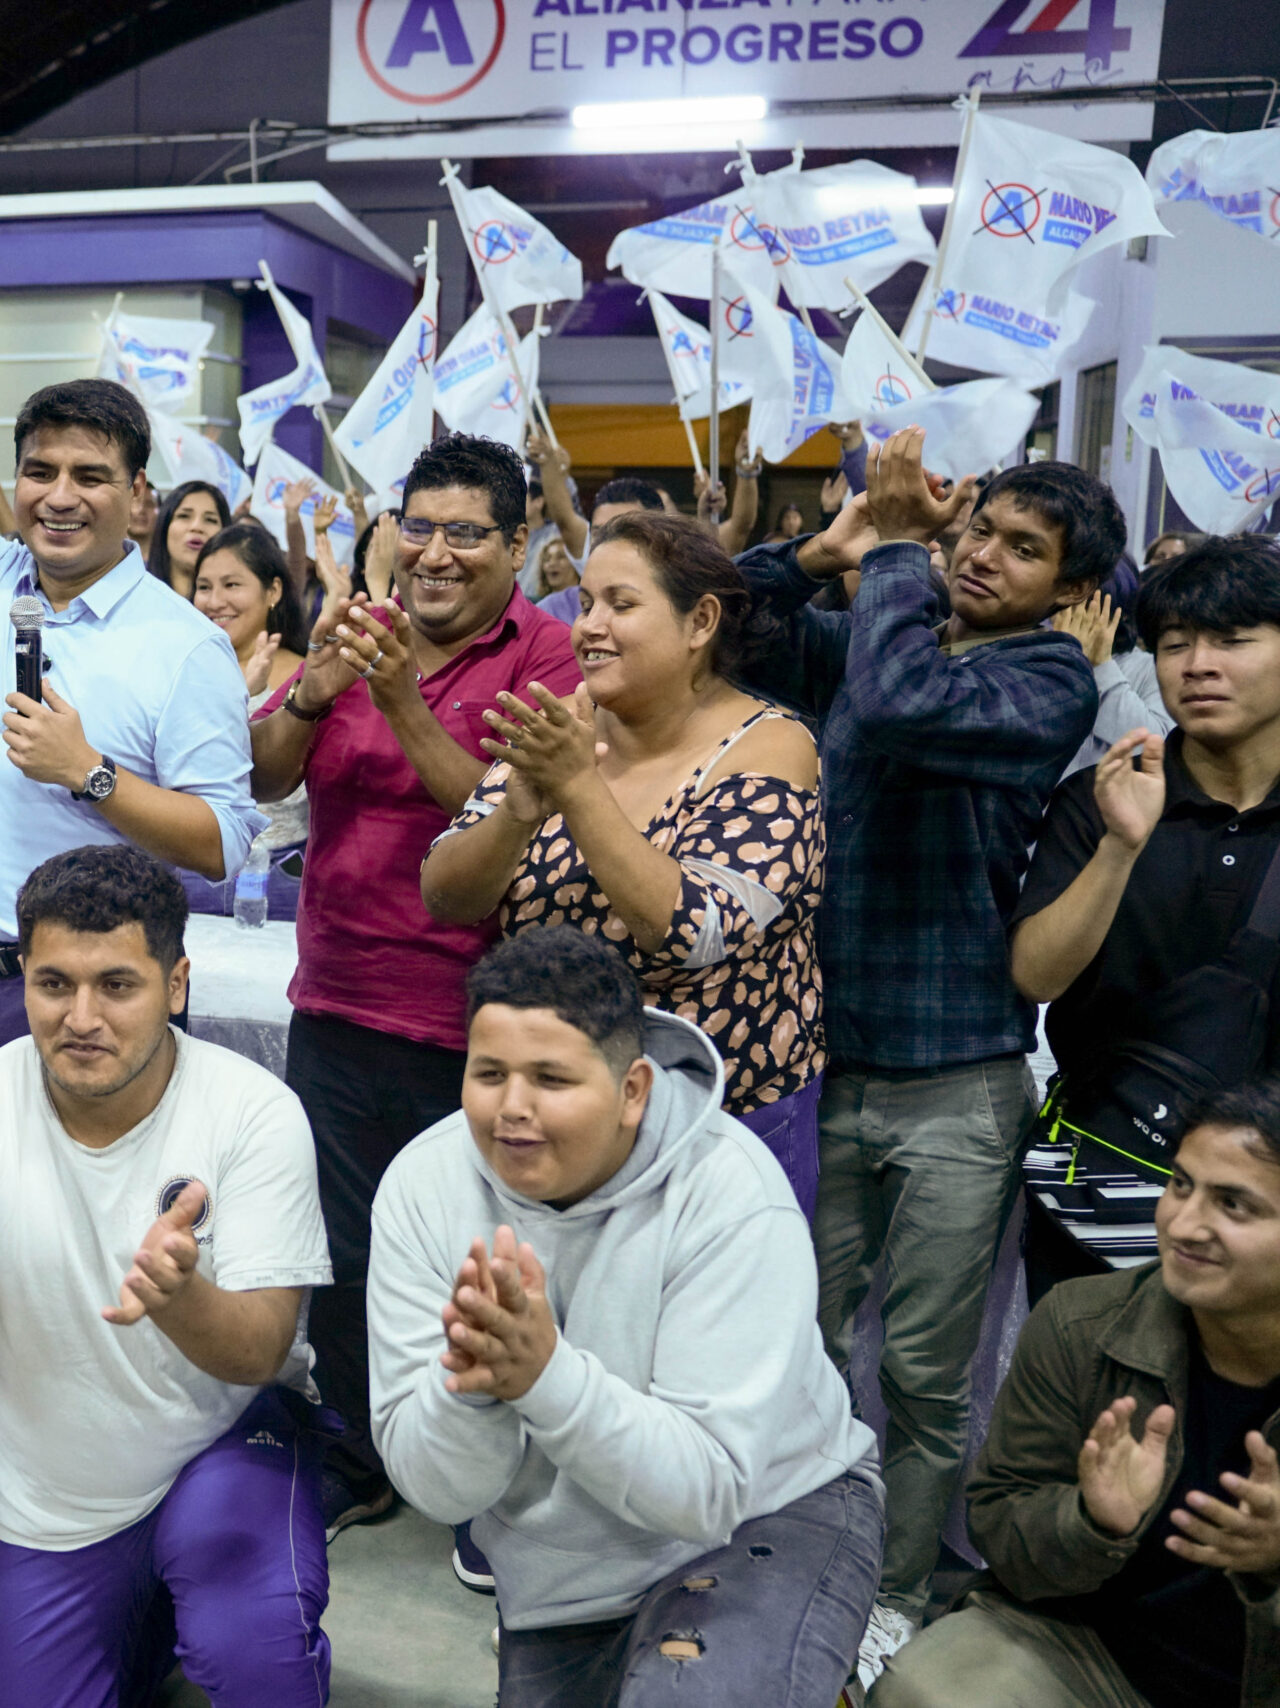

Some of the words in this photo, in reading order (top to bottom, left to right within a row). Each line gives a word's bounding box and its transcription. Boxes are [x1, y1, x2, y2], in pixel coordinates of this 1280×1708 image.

[530, 32, 583, 71] EL
[604, 16, 924, 69] PROGRESO
[823, 205, 892, 241] REYNA
